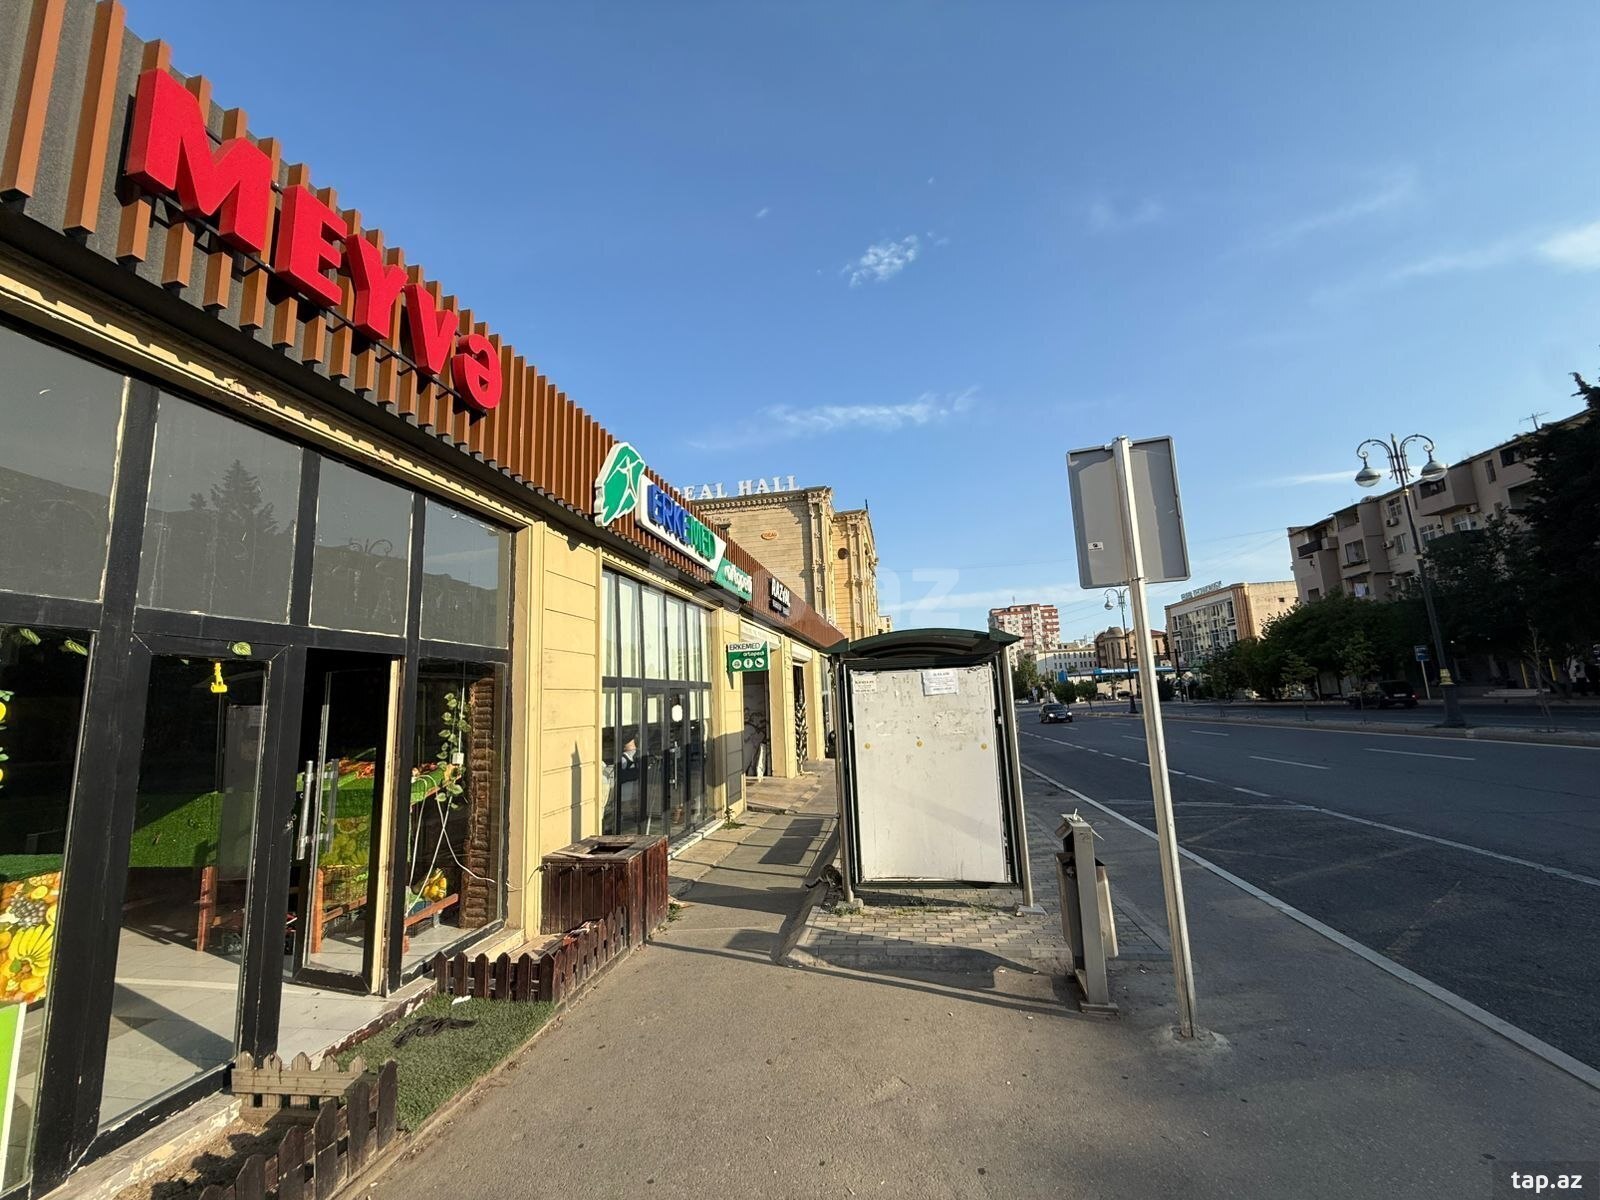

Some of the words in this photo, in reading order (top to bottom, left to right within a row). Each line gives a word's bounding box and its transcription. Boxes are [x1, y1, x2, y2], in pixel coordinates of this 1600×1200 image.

[737, 475, 800, 496] HALL
[647, 484, 717, 561] ERKEMED
[729, 642, 761, 651] ERKEMED
